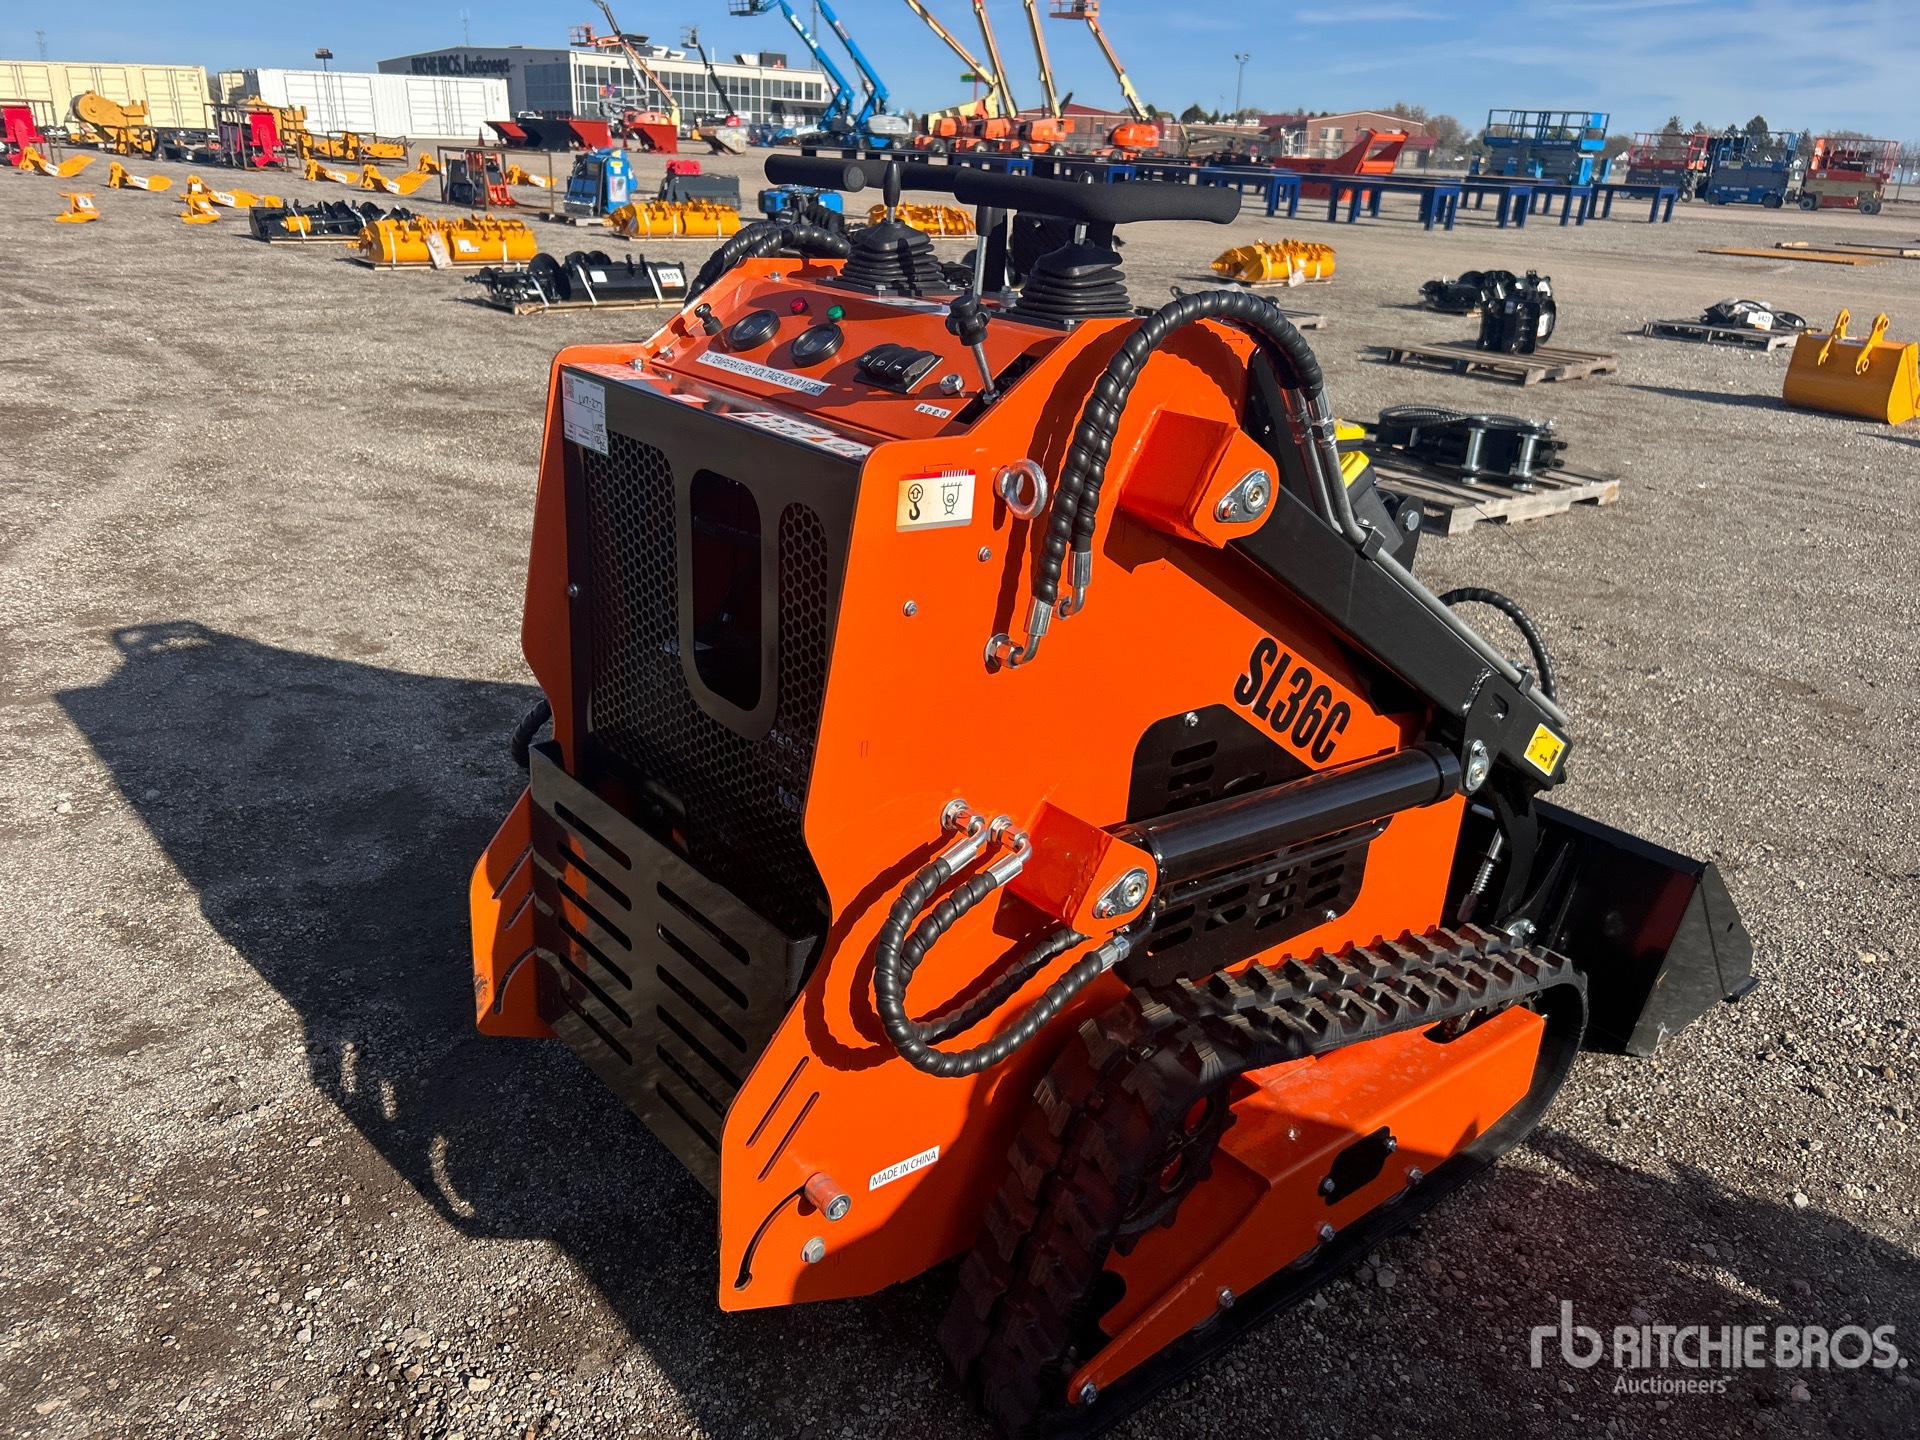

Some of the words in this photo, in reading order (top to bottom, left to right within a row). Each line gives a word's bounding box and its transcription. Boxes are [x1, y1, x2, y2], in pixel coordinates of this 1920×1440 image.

[780, 373, 803, 388] HOUR
[800, 381, 825, 394] METER
[1233, 637, 1351, 763] SL36C
[872, 1166, 898, 1186] MADE
[900, 1162, 910, 1174] IN
[911, 1150, 937, 1169] CHINA
